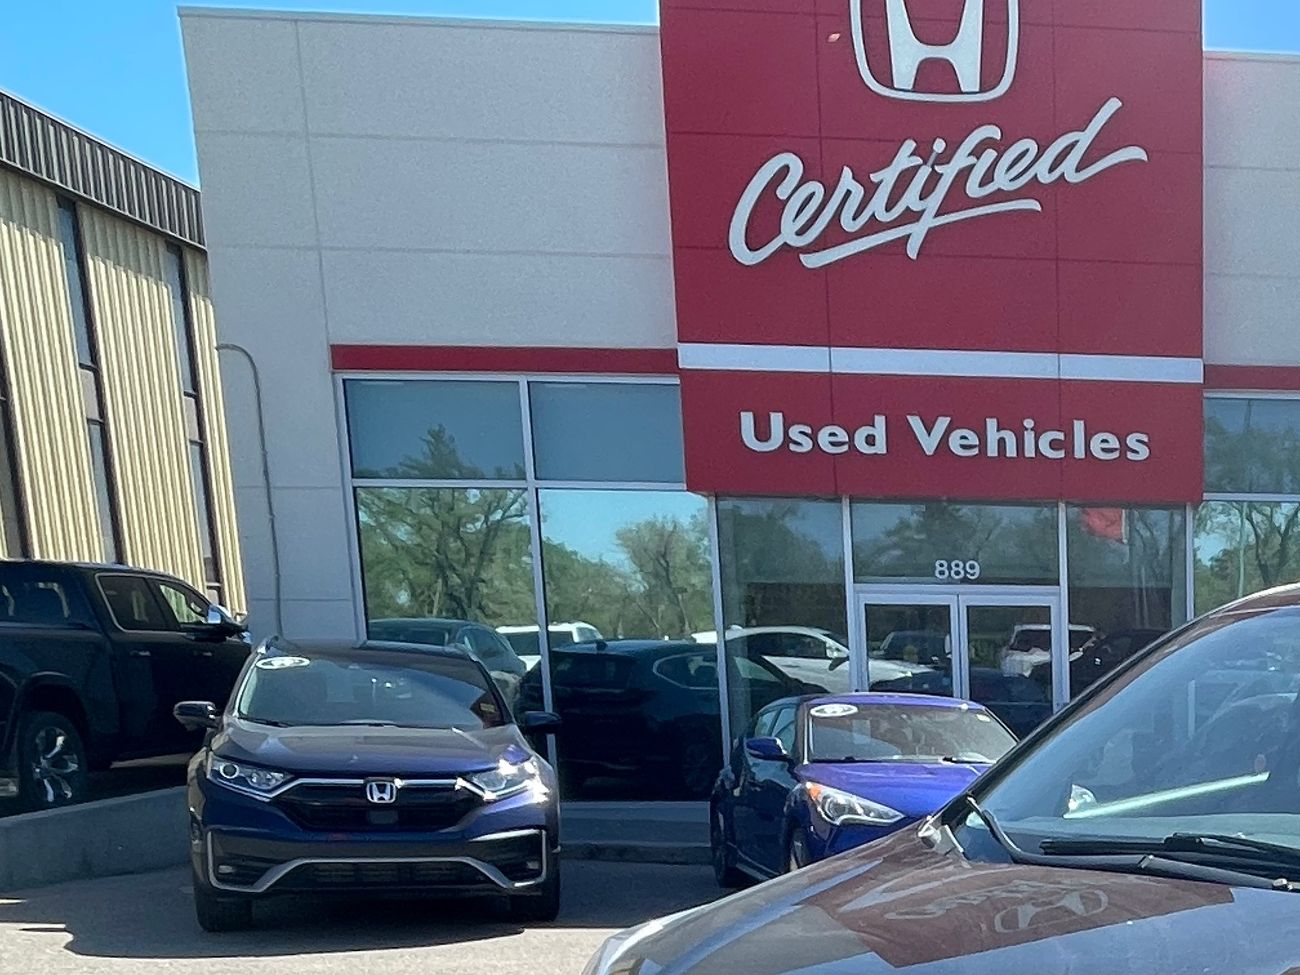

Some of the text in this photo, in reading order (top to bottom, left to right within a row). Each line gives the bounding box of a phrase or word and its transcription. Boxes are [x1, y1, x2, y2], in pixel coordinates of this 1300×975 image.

[728, 97, 1148, 269] Certified
[739, 411, 1151, 461] Used Vehicles
[934, 559, 981, 580] 889
